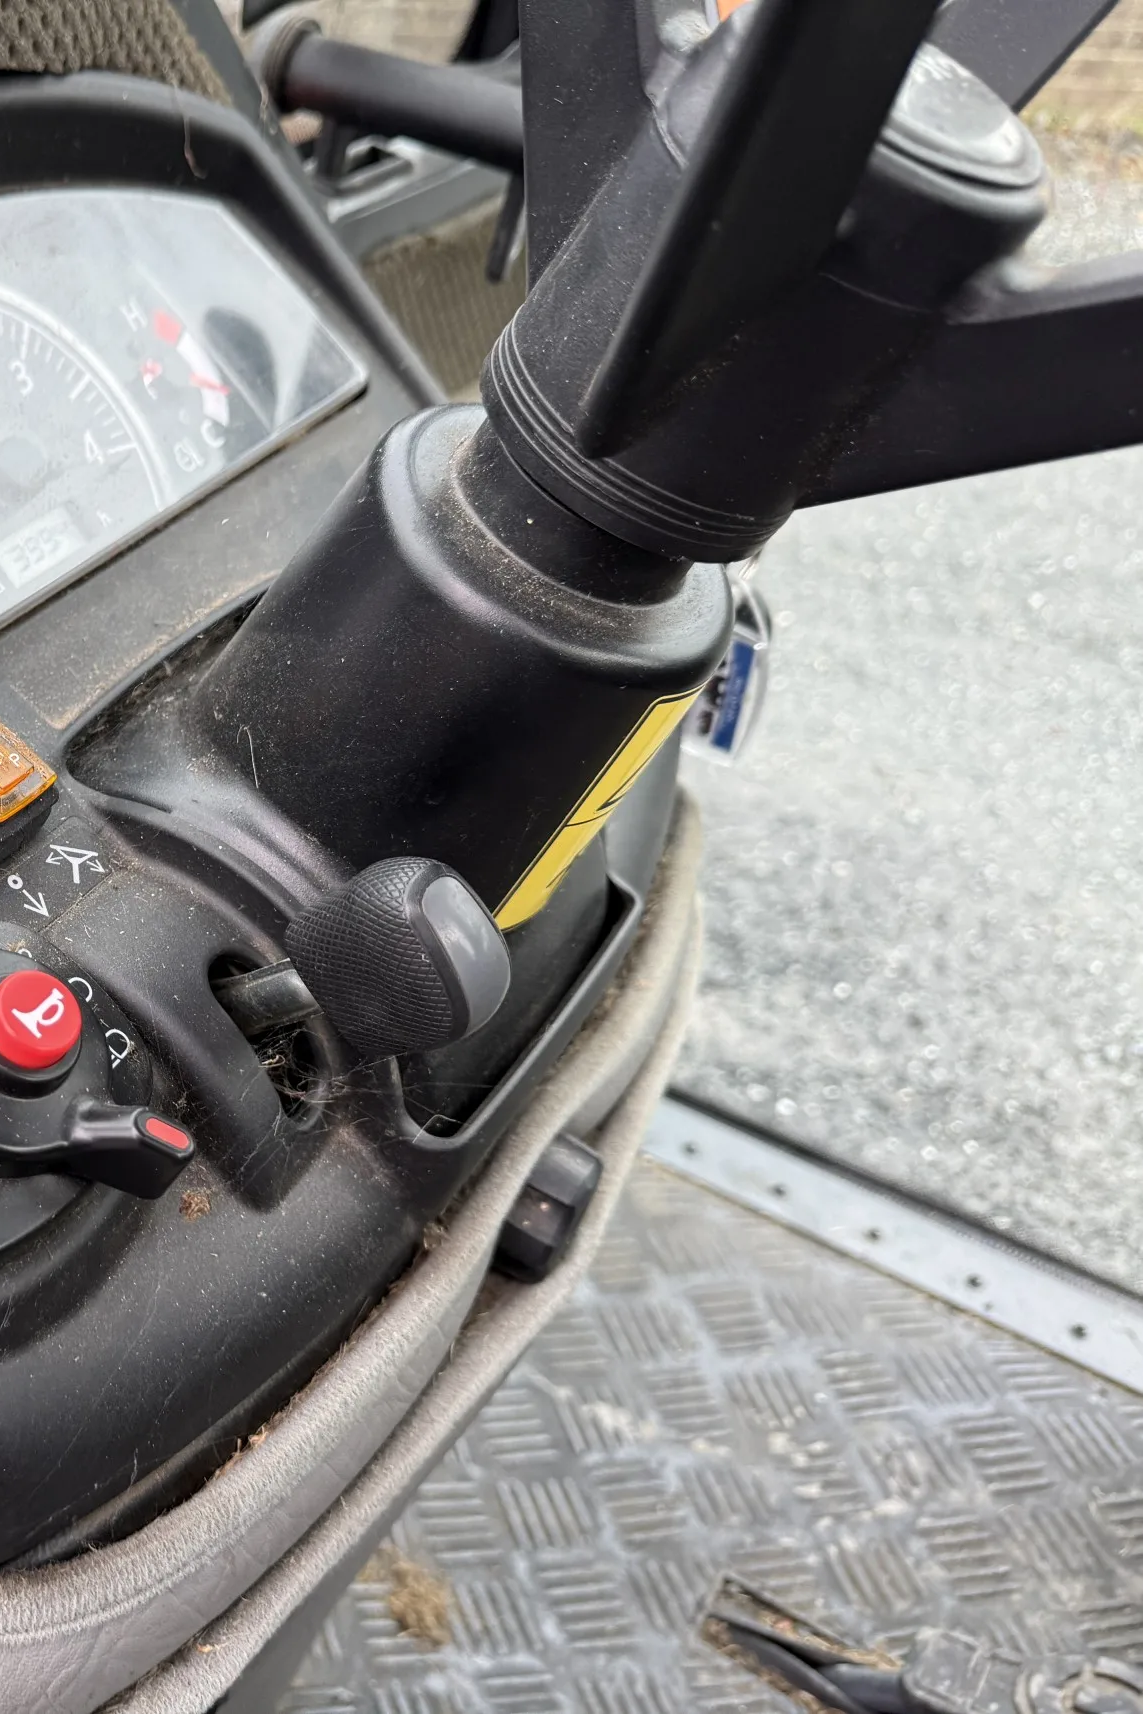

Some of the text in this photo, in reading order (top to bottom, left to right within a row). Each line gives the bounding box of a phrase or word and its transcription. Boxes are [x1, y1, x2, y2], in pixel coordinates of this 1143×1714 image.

[120, 296, 148, 332] H
[9, 360, 34, 396] 3
[83, 431, 105, 466] 4
[200, 419, 227, 448] C
[8, 752, 20, 768] P
